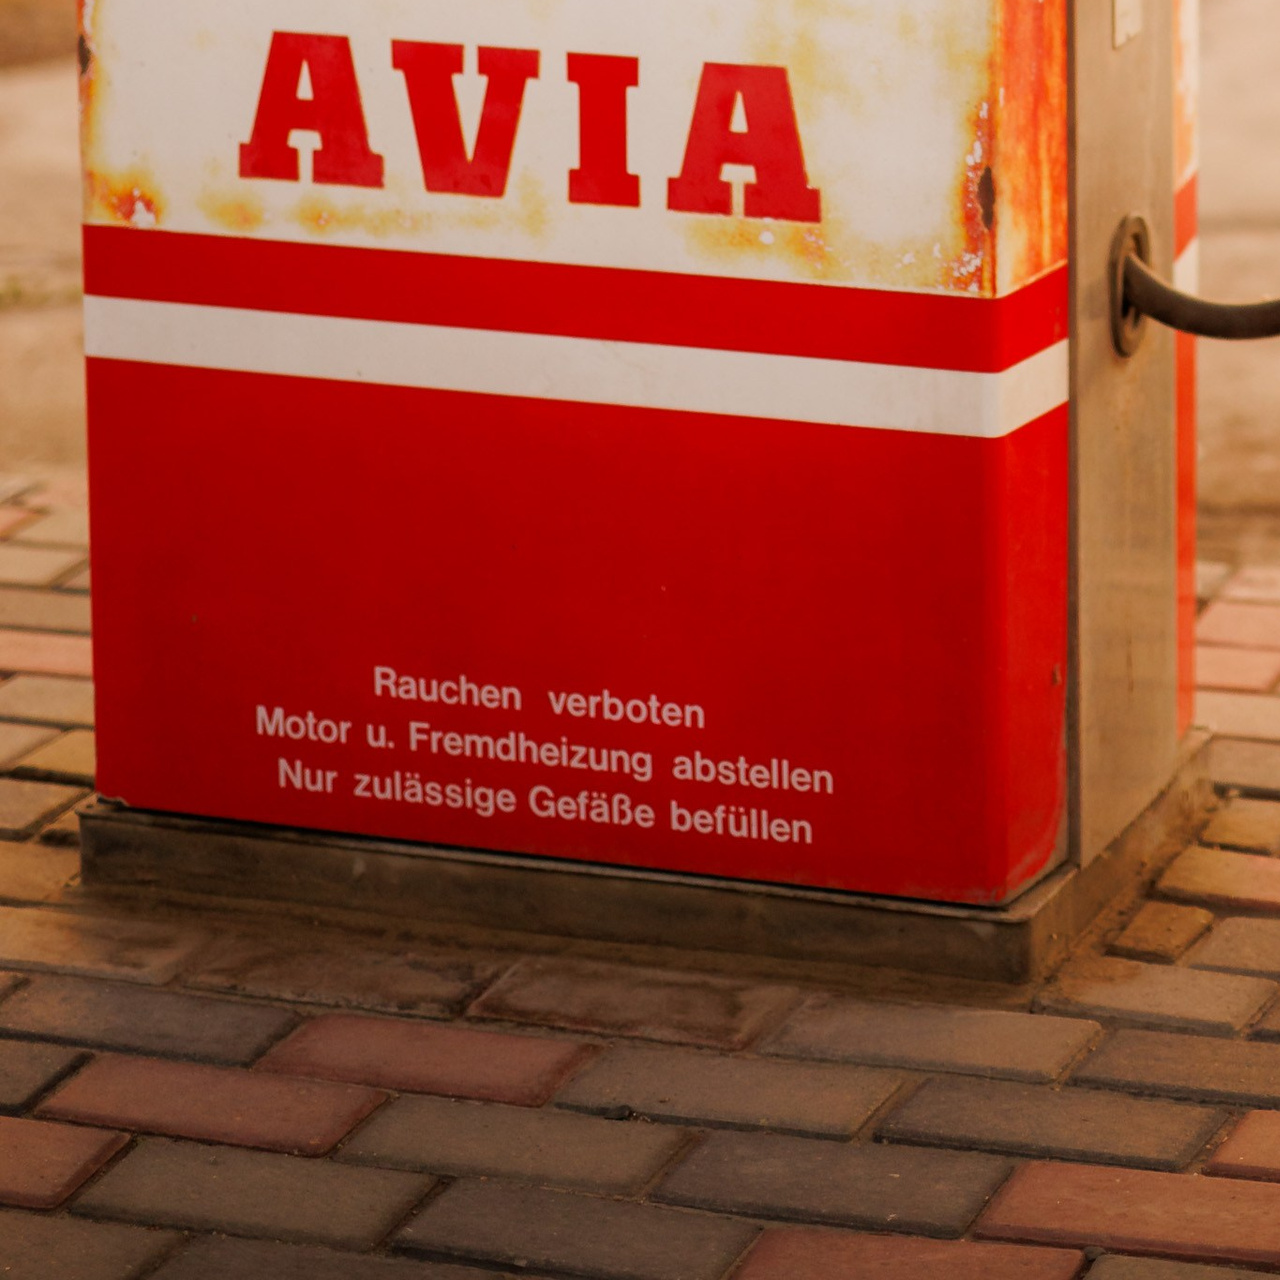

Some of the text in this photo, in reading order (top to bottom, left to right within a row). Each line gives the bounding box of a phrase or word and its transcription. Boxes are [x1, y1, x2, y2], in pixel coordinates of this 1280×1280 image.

[239, 31, 822, 224] AVIA
[373, 665, 705, 728] Rauchen verboten
[255, 704, 834, 795] Motor u. Fremdheizung abstellen
[277, 757, 813, 844] Nur zulässige Gefäße befüllen
